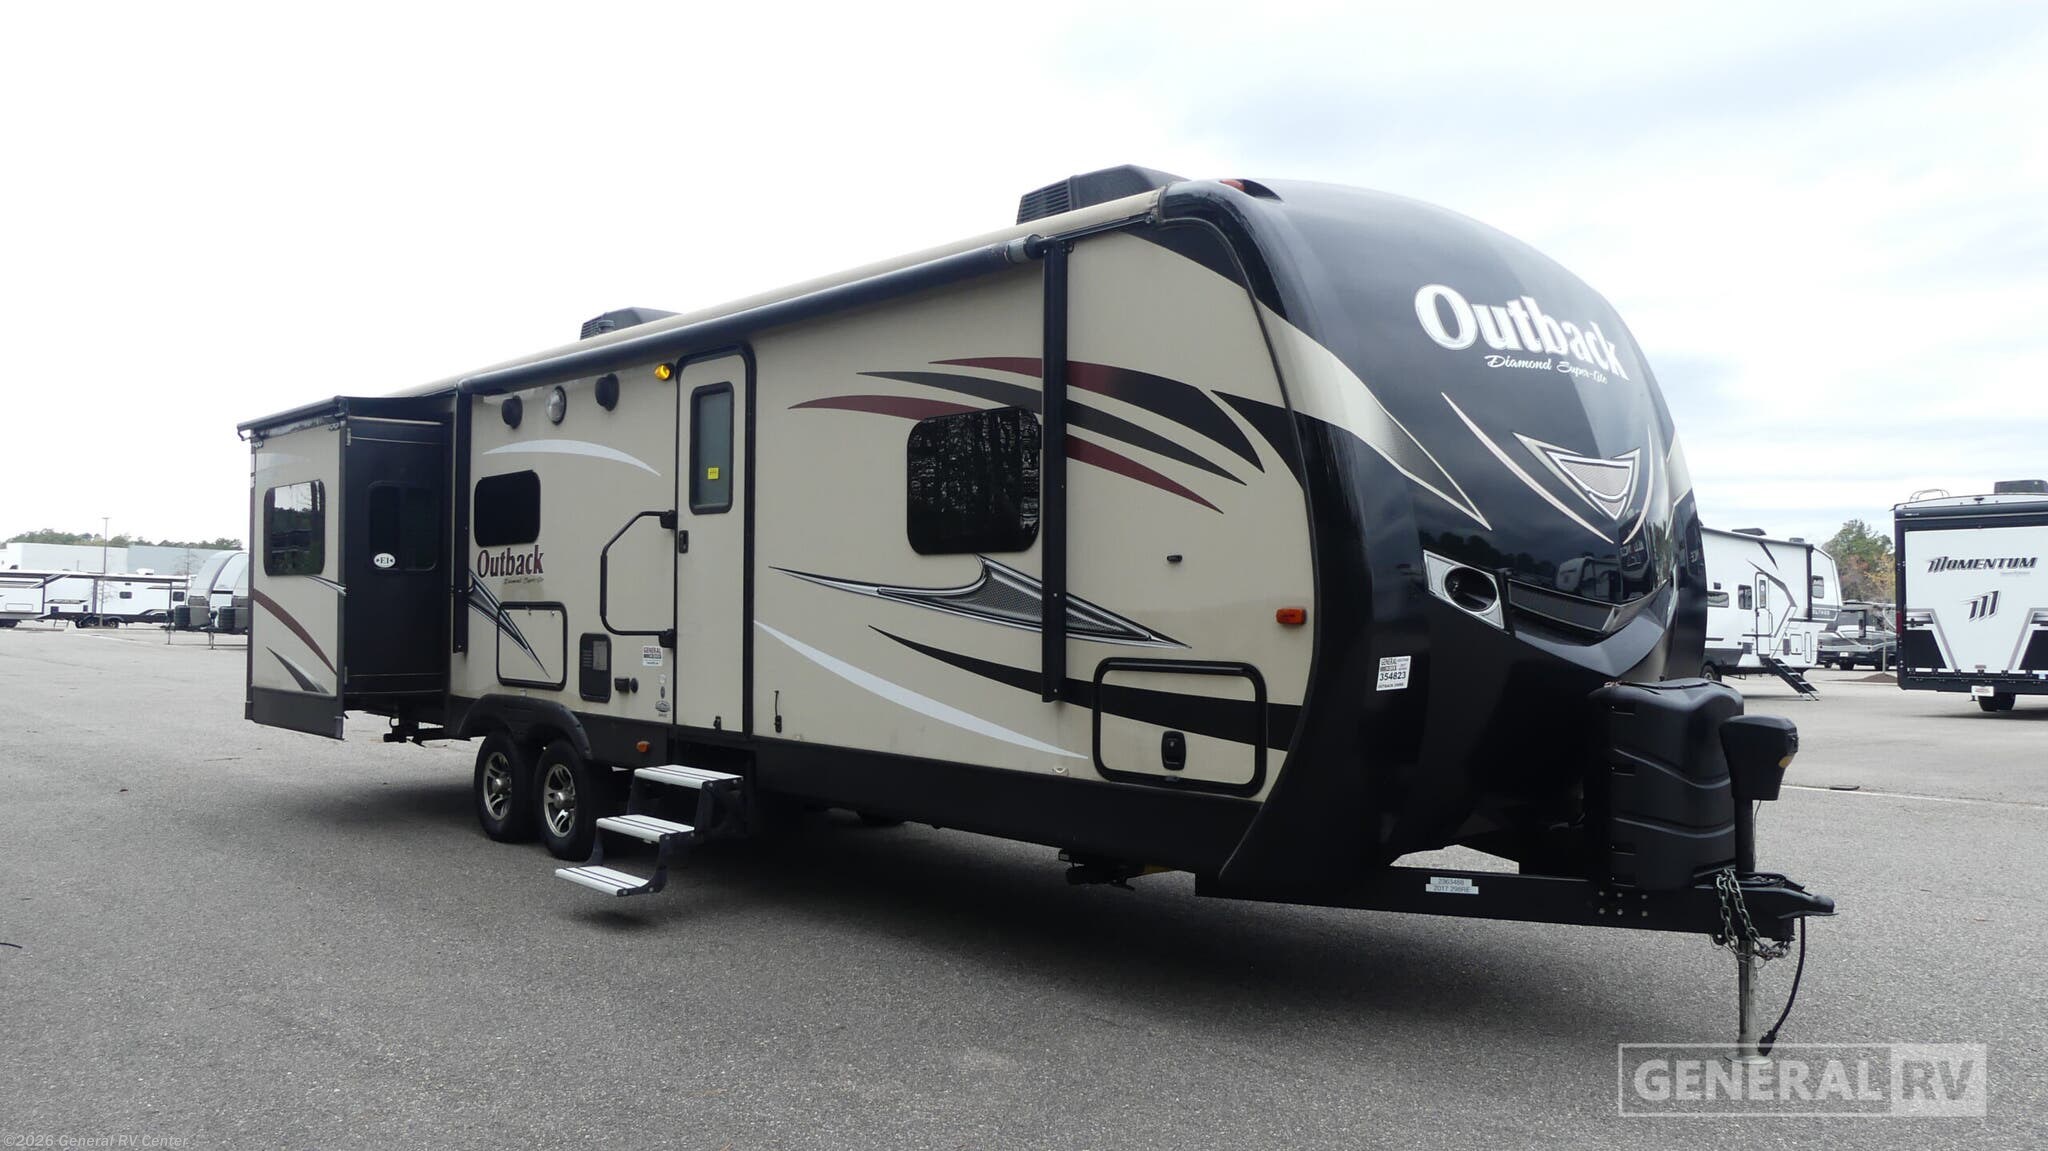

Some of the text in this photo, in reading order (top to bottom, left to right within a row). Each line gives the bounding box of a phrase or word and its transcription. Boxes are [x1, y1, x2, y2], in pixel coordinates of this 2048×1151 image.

[1414, 284, 1630, 381] Outback
[1484, 354, 1552, 371] Diamond
[477, 544, 545, 578] Outback
[1926, 556, 2038, 573] MOMENTUM
[1379, 672, 1406, 681] 354823
